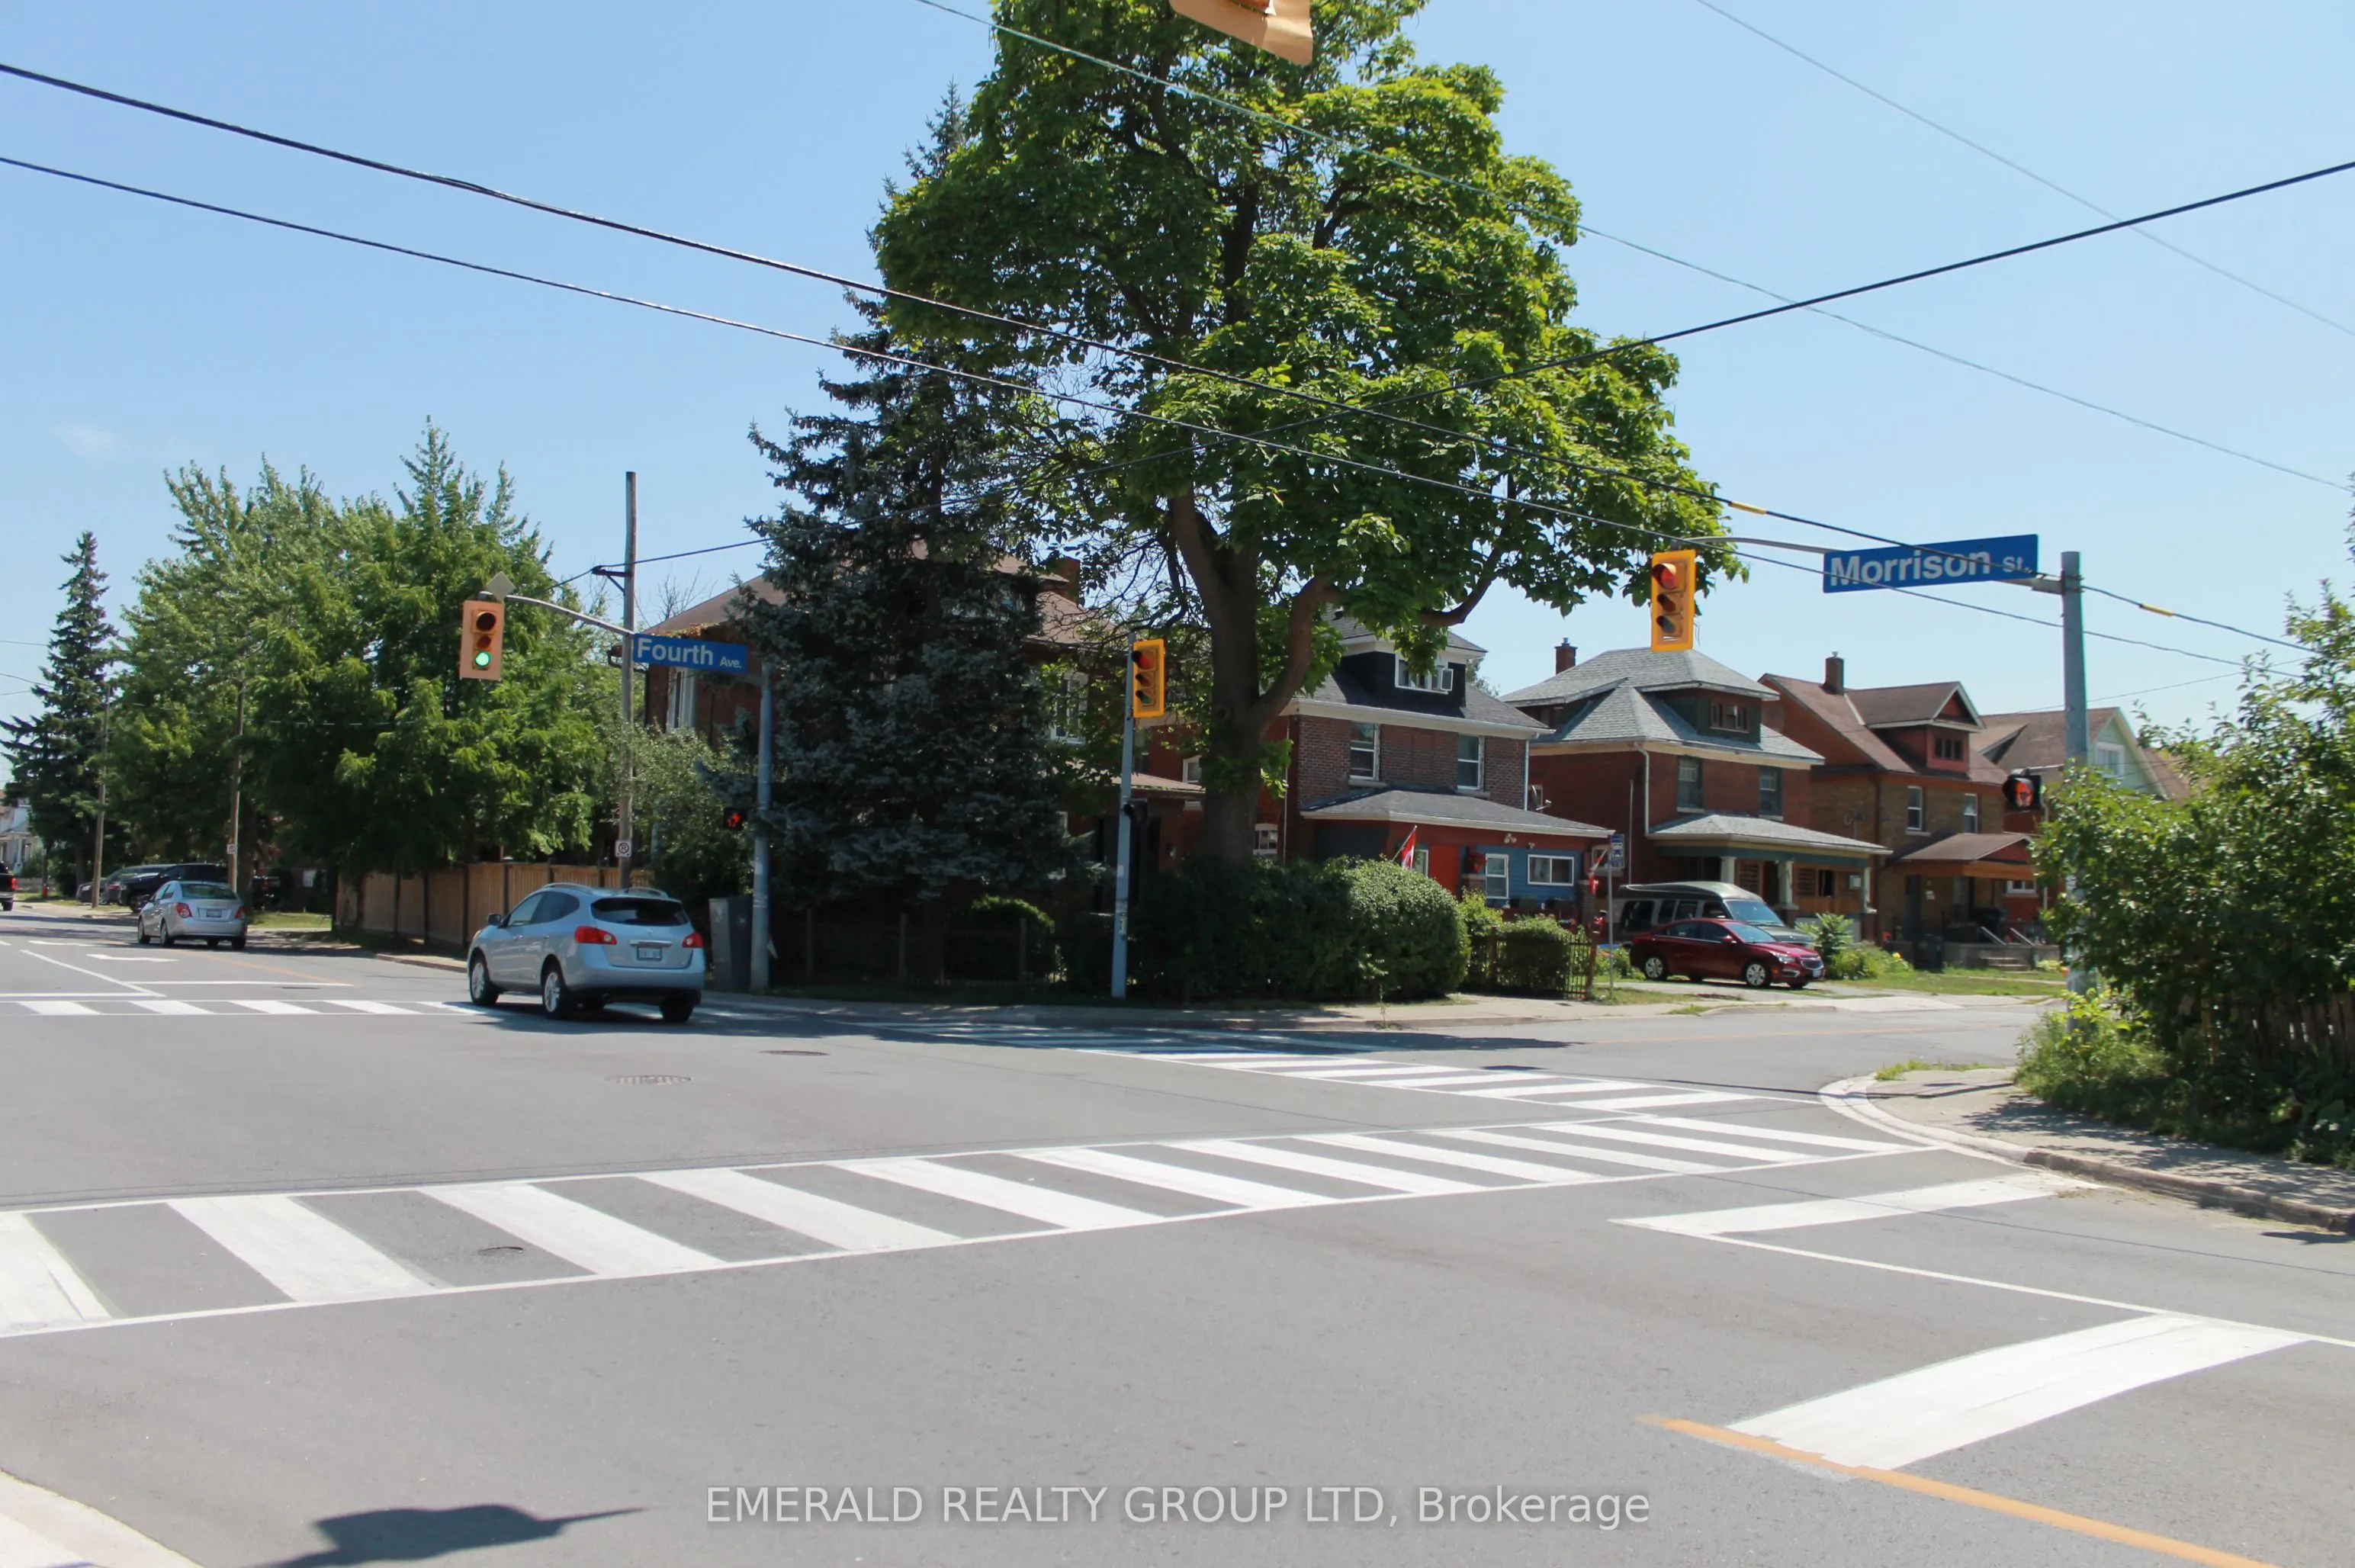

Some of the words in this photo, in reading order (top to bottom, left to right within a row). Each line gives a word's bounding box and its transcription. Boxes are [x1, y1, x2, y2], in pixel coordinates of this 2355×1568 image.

[1830, 550, 1991, 586] Morrison
[637, 638, 714, 666] Fourth
[719, 656, 742, 669] Ave.
